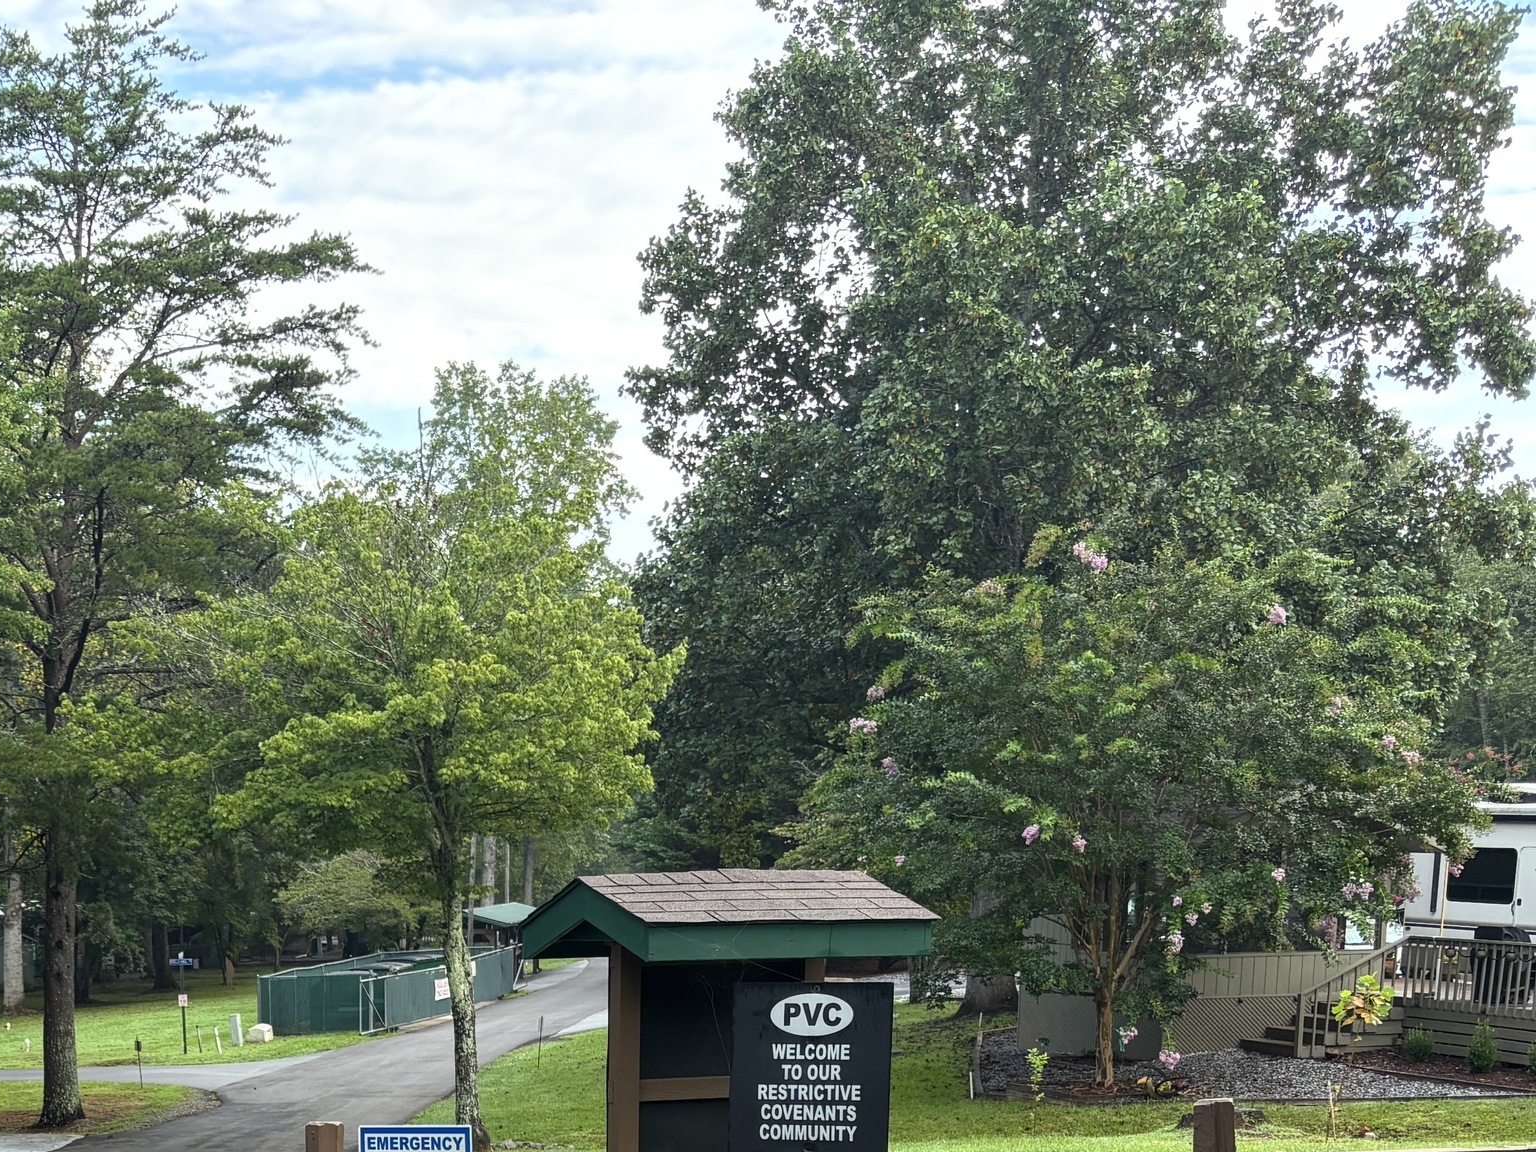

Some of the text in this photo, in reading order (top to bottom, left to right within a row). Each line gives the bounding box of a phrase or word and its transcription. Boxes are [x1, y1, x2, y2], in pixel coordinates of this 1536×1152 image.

[783, 1002, 842, 1027] PVC
[772, 1043, 850, 1061] WELCOME
[782, 1064, 841, 1081] TO OUR
[758, 1084, 861, 1101] RESTRICTIVE
[761, 1104, 857, 1122] COVENANTS
[759, 1124, 857, 1142] COMMUNITY
[367, 1136, 463, 1151] EMERGENCY
